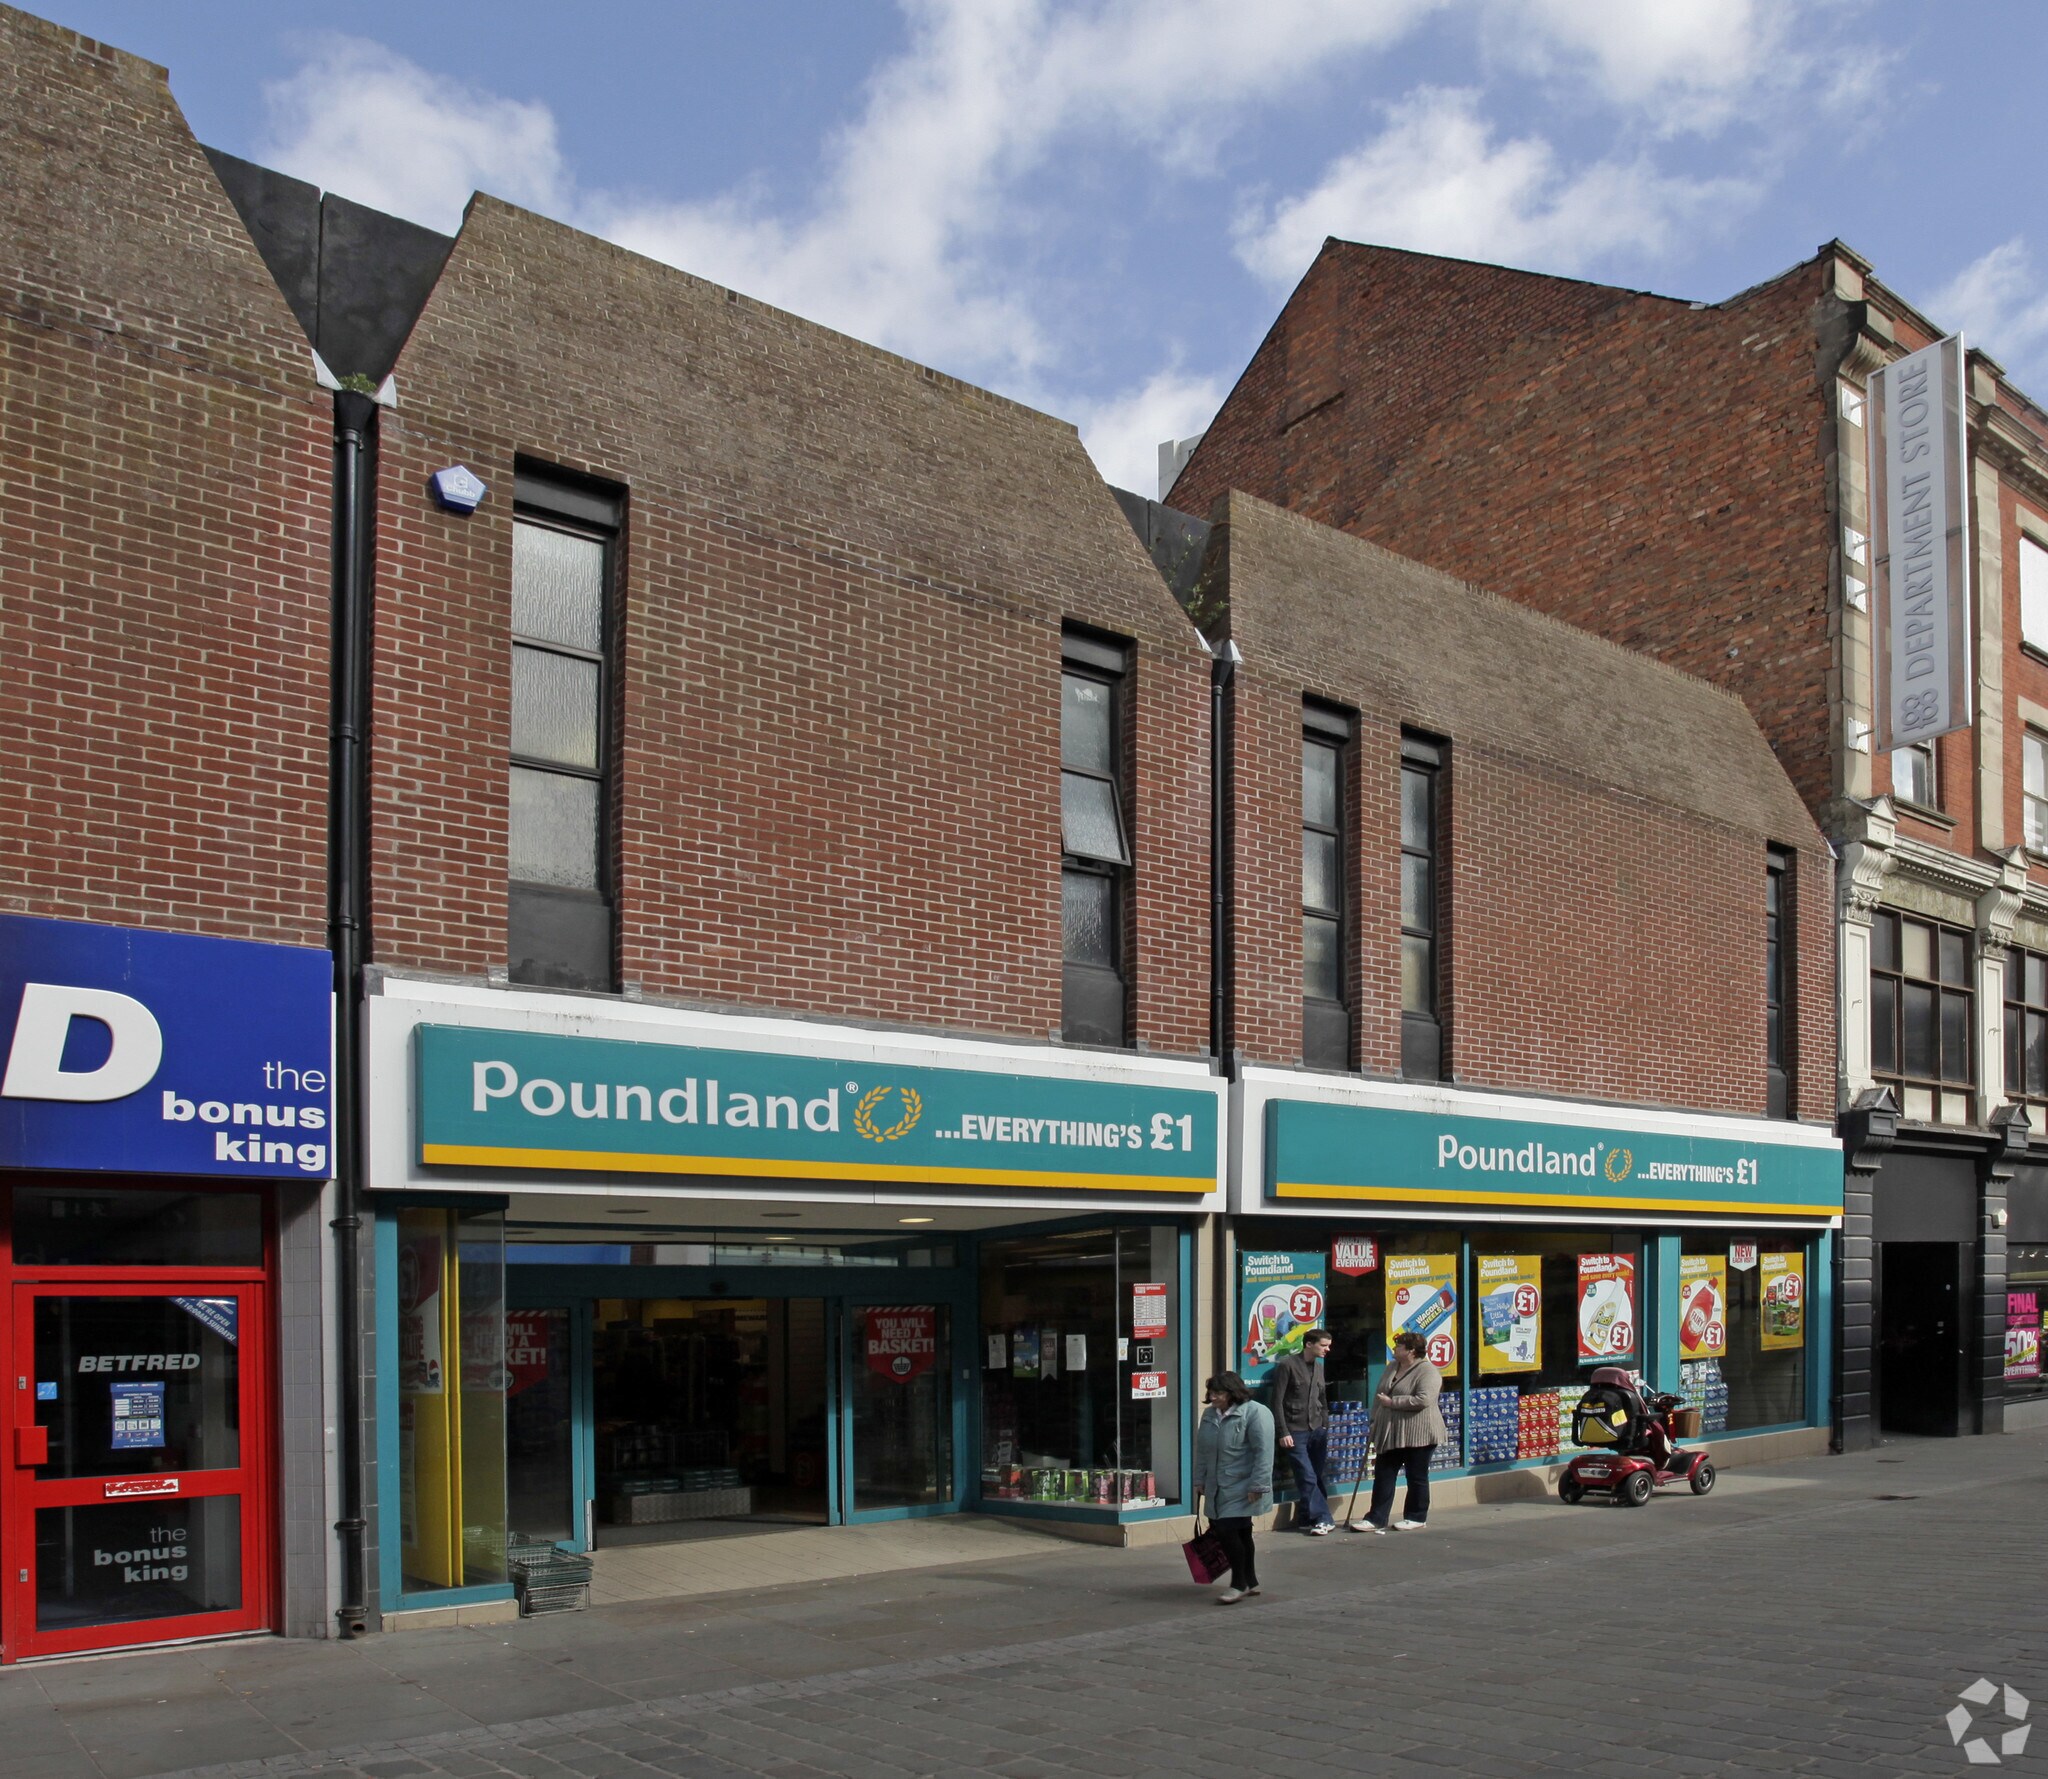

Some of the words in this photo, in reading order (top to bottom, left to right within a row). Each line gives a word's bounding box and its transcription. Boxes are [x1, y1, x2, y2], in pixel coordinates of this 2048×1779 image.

[1898, 358, 1930, 466] STORE
[1902, 471, 1934, 681] DEPARTMENT
[1, 982, 163, 1102] D
[263, 1061, 326, 1092] the
[163, 1091, 326, 1128] bonus
[472, 1060, 839, 1132] Poundland
[935, 1114, 1142, 1149] ...EVERYTHING'S
[1150, 1112, 1192, 1151] £1
[215, 1132, 326, 1171] king
[1438, 1134, 1596, 1176] Poundland
[1736, 1158, 1757, 1185] £1
[1335, 1244, 1374, 1259] VALUE
[1735, 1245, 1752, 1257] NEW
[1248, 1255, 1280, 1266] Switch
[1280, 1255, 1290, 1264] to
[1336, 1258, 1375, 1268] EVERYDAY!
[1390, 1258, 1418, 1269] Switch
[1418, 1257, 1426, 1266] to
[1483, 1258, 1507, 1268] Switch
[1507, 1258, 1515, 1266] to
[1580, 1263, 1612, 1274] Poundland
[1581, 1256, 1603, 1266] Switch
[1603, 1256, 1610, 1264] to
[1245, 1264, 1294, 1276] Poundland
[1388, 1266, 1430, 1278] Poundland
[1481, 1266, 1518, 1277] Poundland
[1786, 1280, 1799, 1296] £1
[1293, 1294, 1318, 1317] £1
[1517, 1292, 1535, 1312] £1
[2008, 1293, 2039, 1314] FINAL
[175, 1297, 186, 1305] AT
[207, 1319, 237, 1341] SUNDAYS!
[213, 1313, 231, 1327] OPEN
[1416, 1302, 1440, 1324] WAGON
[1419, 1306, 1443, 1330] WHEELS
[1691, 1311, 1704, 1327] FAIRY
[875, 1318, 897, 1329] YOU
[900, 1317, 928, 1328] WILL
[881, 1328, 912, 1339] NEED
[913, 1327, 923, 1338] A
[1612, 1326, 1629, 1347] £1
[1706, 1327, 1721, 1345] £1
[868, 1338, 935, 1355] BASKET!
[1430, 1341, 1451, 1362] £1
[2004, 1331, 2037, 1364] 50%
[78, 1353, 200, 1373] BETFRED
[2004, 1365, 2038, 1376] EVERYTHING
[1139, 1376, 1159, 1384] CASH
[150, 1527, 187, 1542] the
[94, 1544, 187, 1566] bonus
[124, 1563, 188, 1583] king
